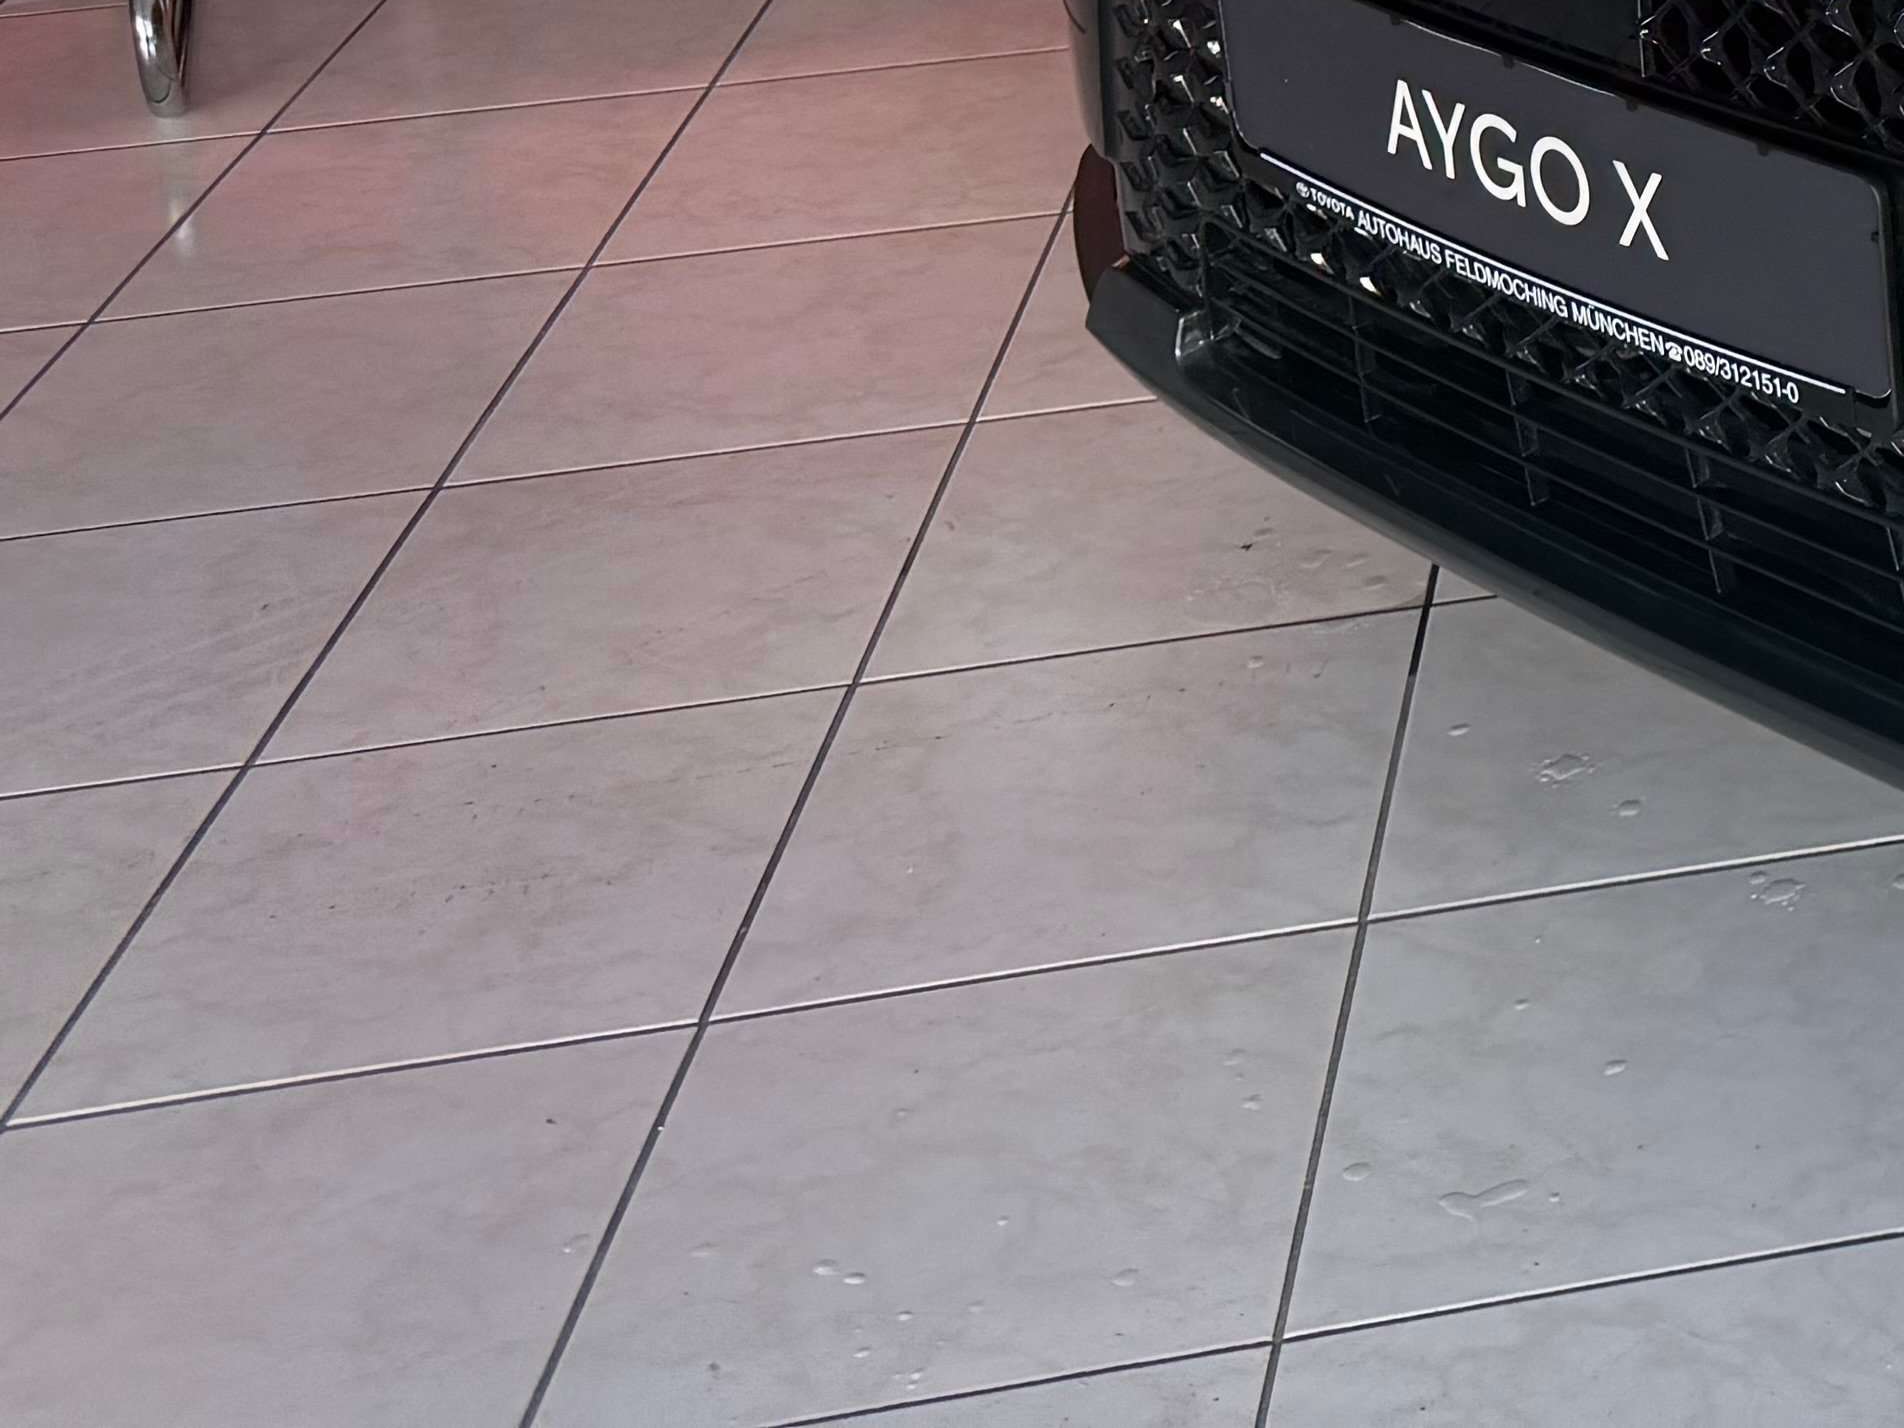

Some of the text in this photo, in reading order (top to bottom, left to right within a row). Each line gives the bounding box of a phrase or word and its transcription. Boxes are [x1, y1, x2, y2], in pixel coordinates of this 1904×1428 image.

[1386, 78, 1670, 262] AYGO X
[1310, 186, 1801, 406] TOYOTA AUTOHAUS FELDMOCHING MÜNCHEN 089/312151-0
